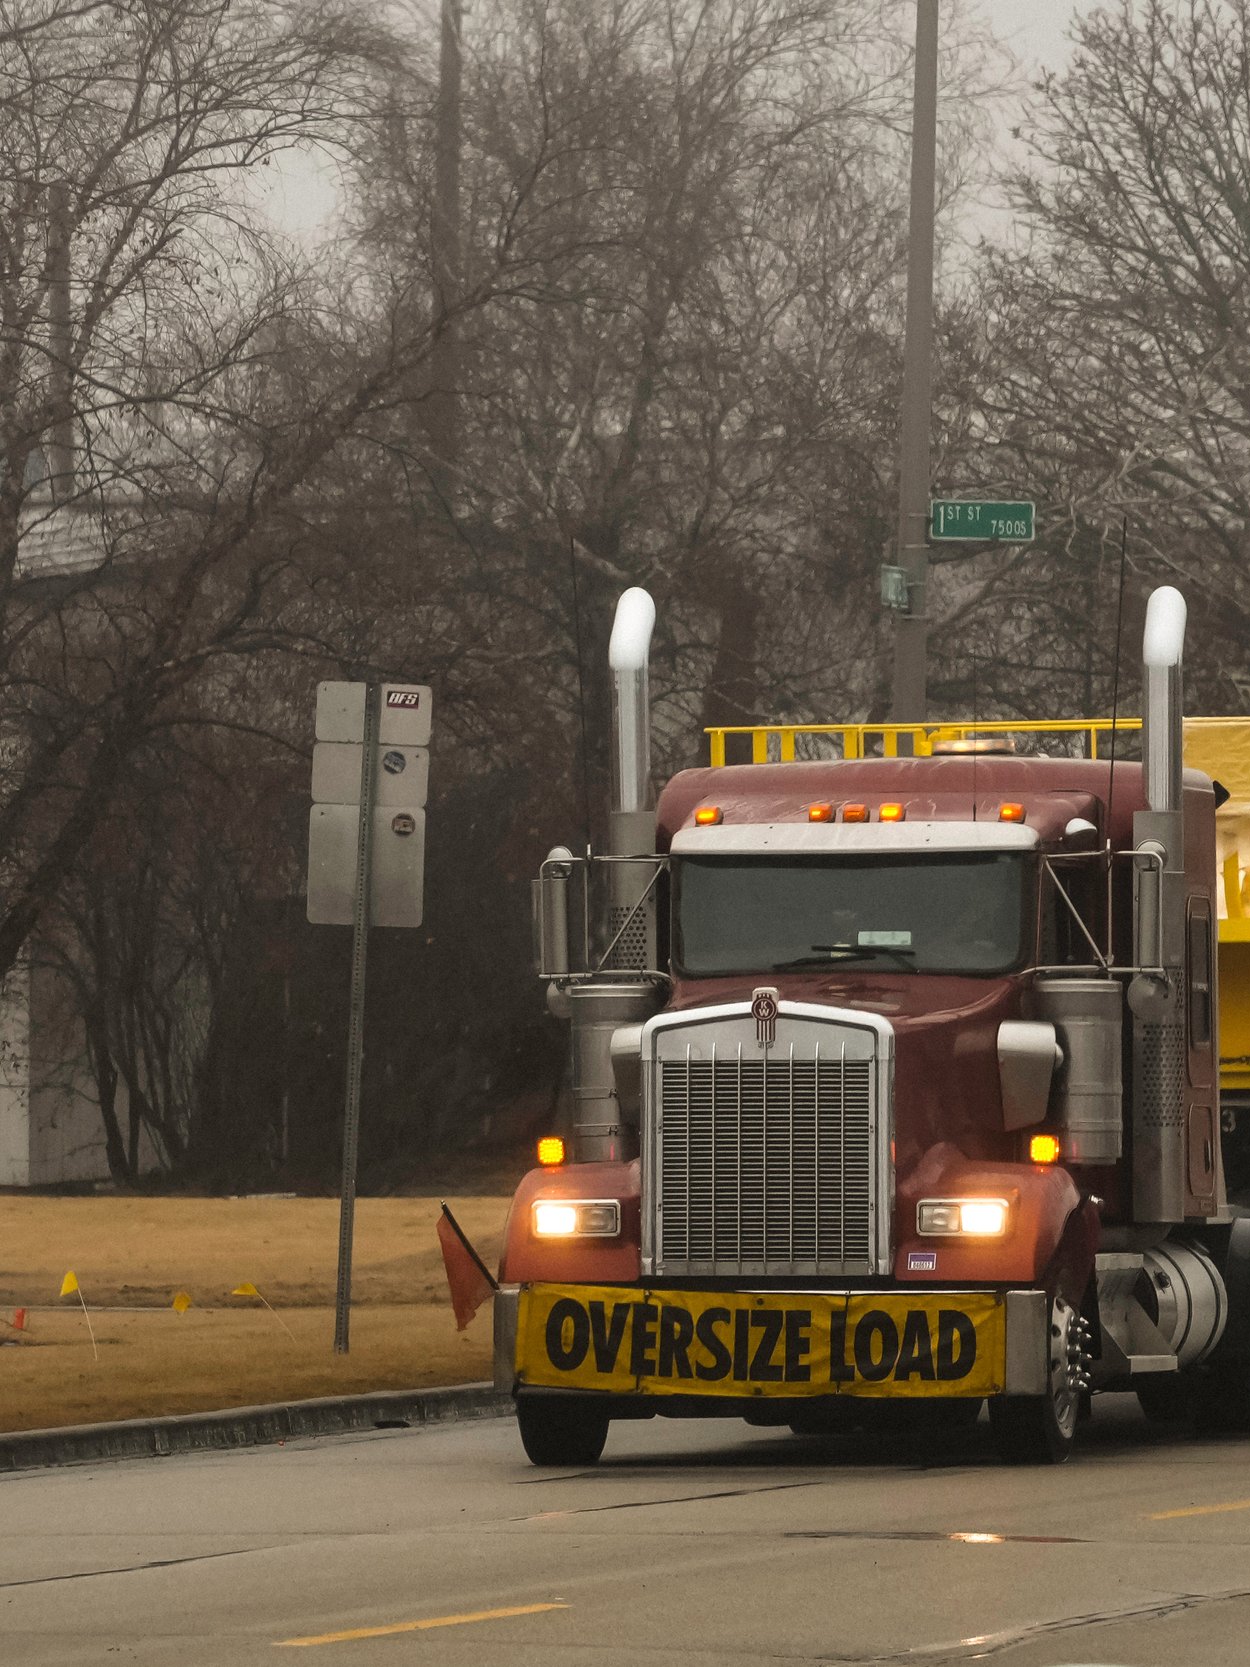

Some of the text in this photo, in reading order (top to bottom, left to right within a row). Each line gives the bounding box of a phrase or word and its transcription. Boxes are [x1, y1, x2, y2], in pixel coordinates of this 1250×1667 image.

[940, 505, 981, 533] 1ST ST
[991, 520, 1026, 535] 7500S
[545, 1297, 977, 1382] OVERSIZE LOAD
